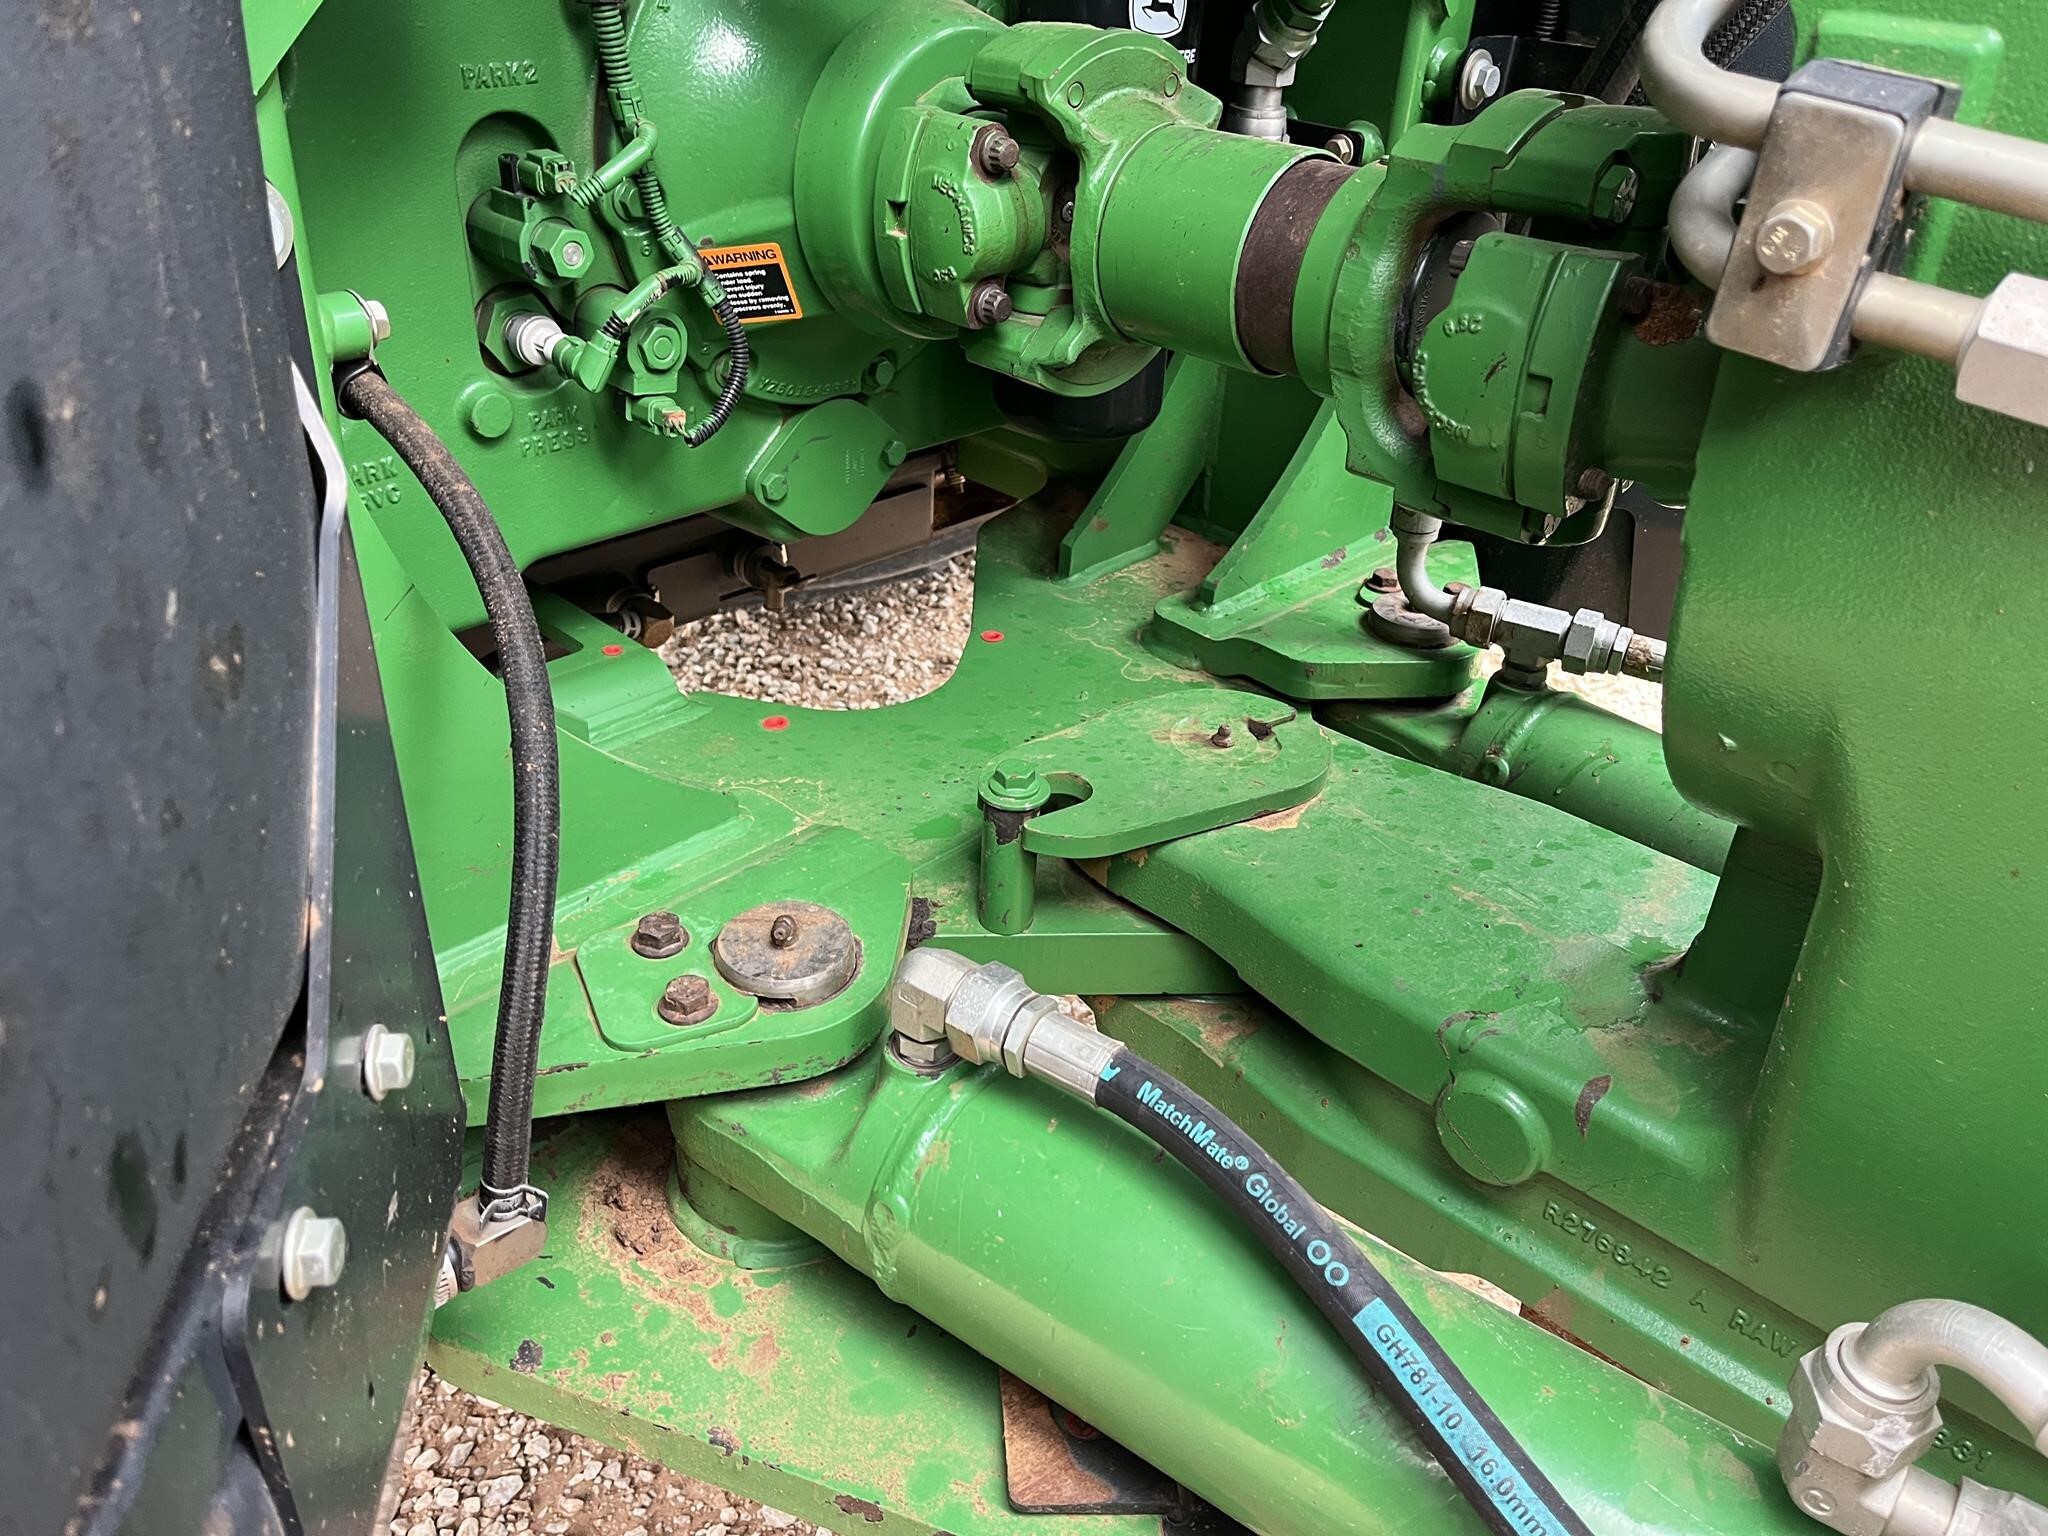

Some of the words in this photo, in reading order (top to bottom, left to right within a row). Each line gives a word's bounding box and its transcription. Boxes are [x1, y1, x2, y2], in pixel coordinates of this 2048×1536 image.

[460, 60, 538, 90] PARK2
[711, 249, 777, 265] WARNING
[744, 269, 767, 277] spring
[745, 283, 764, 291] injury
[762, 302, 787, 310] evenly.
[351, 456, 398, 487] ARK
[1245, 1173, 1308, 1241] Global
[1542, 1199, 1673, 1289] R276842
[1728, 1307, 1798, 1358] RAW
[1374, 1322, 1463, 1430] GH781-10
[1469, 1445, 1548, 1536] 16.0mm
